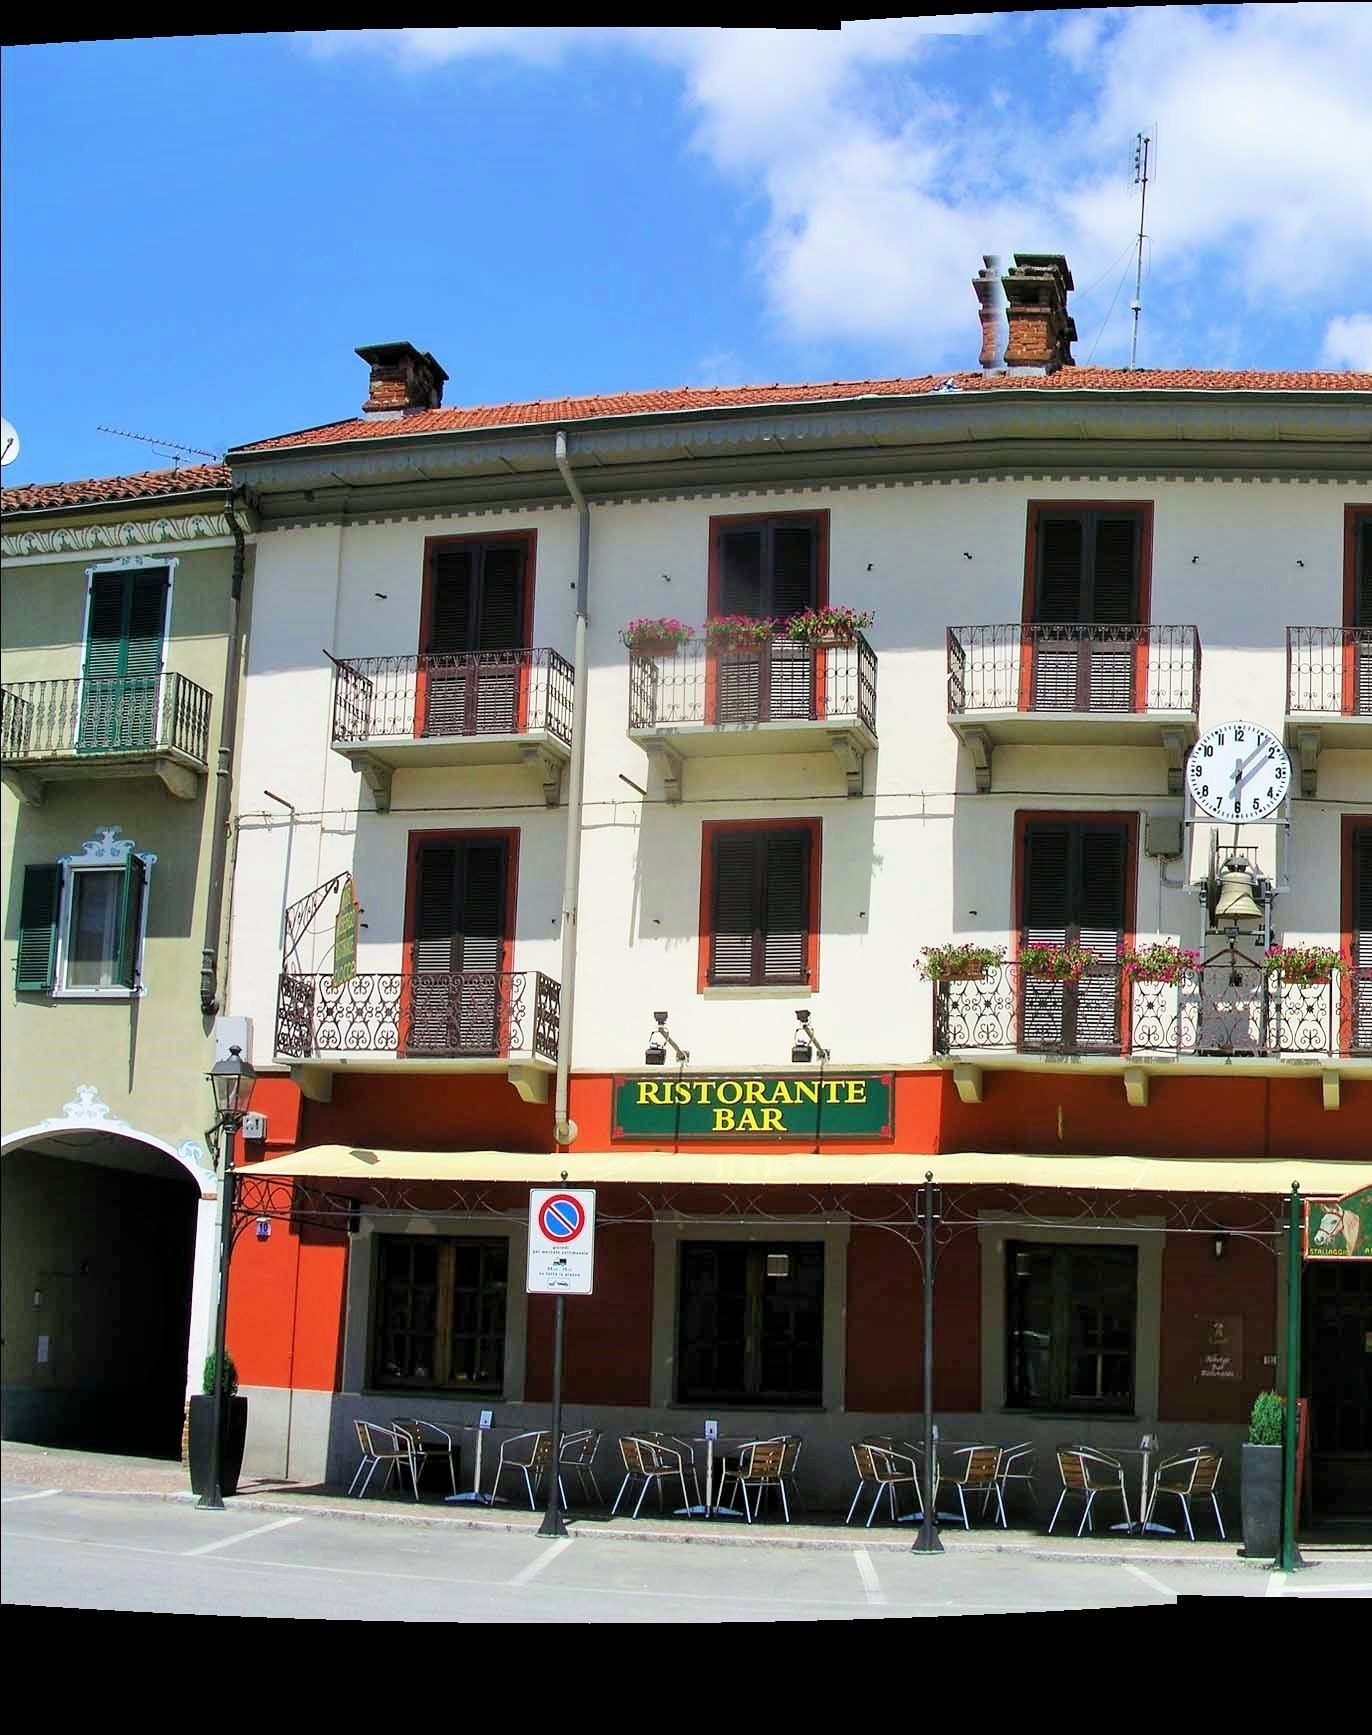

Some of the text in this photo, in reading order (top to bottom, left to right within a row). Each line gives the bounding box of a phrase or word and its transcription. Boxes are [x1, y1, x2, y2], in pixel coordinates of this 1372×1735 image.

[1218, 733, 1224, 746] 11
[1234, 729, 1244, 742] 12
[1257, 734, 1261, 746] 1
[1203, 745, 1213, 757] 10
[1268, 747, 1275, 759] 2
[1195, 765, 1202, 777] 9
[1275, 767, 1282, 779] 3
[1202, 785, 1209, 797] 8
[1267, 786, 1273, 798] 4
[1216, 797, 1223, 809] 7
[1234, 801, 1241, 813] 6
[1252, 798, 1259, 810] 5
[636, 1080, 867, 1105] RISTORANTE
[712, 1107, 787, 1132] BAR
[259, 1222, 269, 1232] 10
